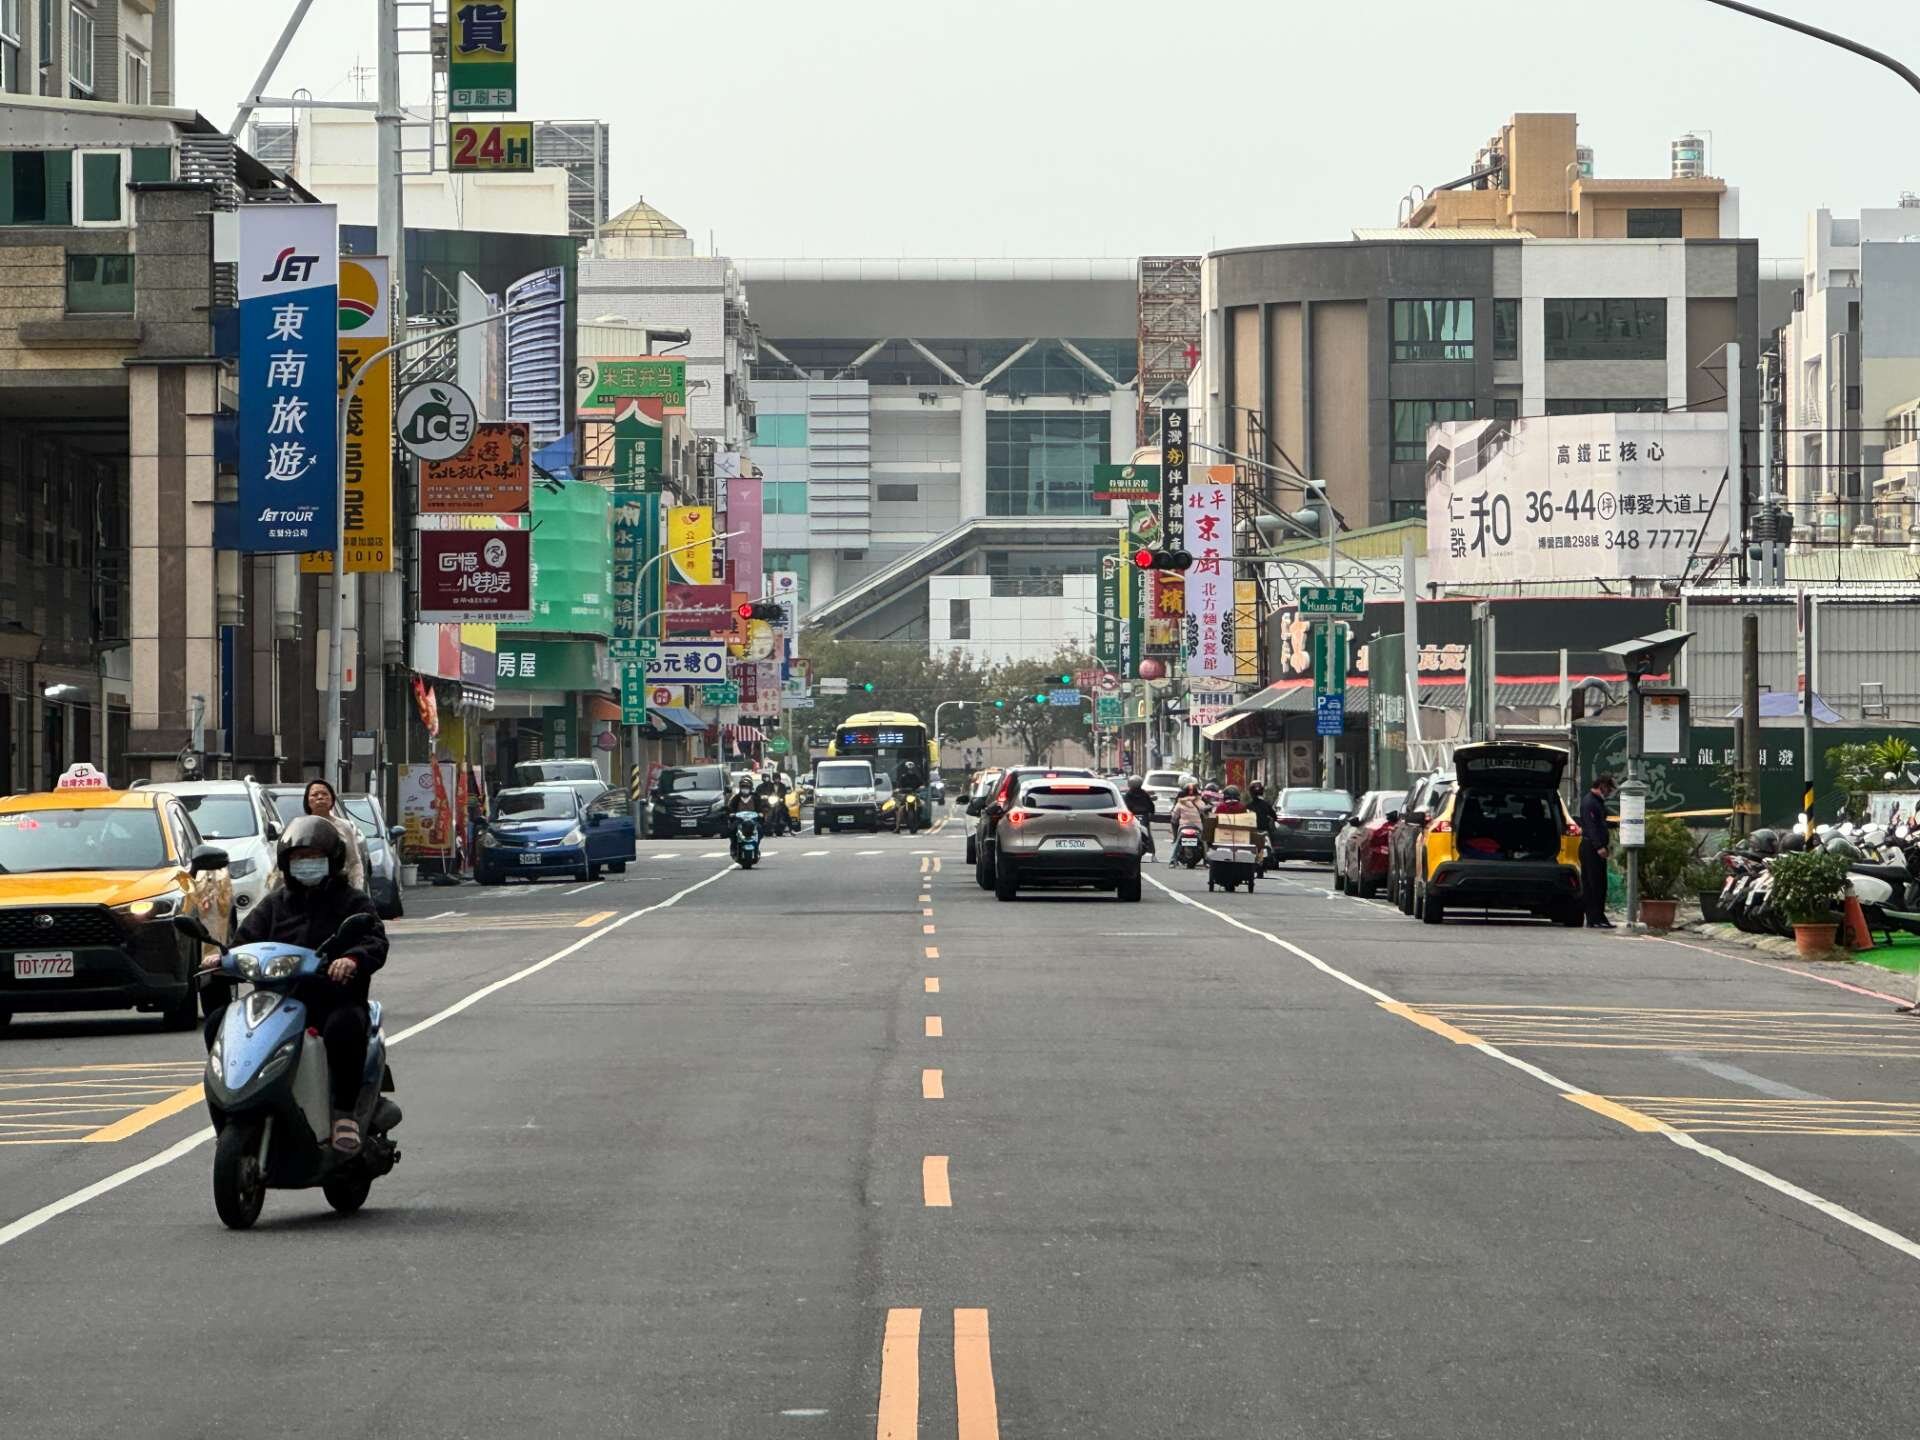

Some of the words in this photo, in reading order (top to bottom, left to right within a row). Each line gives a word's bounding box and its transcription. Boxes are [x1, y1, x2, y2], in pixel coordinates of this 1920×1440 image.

[457, 4, 507, 53] 貨
[456, 90, 509, 105] 可刷卡
[455, 127, 528, 165] 24H
[265, 303, 313, 480] 東南旅遊
[416, 414, 469, 442] ICE
[1557, 442, 1665, 465] 高鐵正核心
[1189, 491, 1226, 510] 北平
[1526, 490, 1596, 523] 36-44
[1618, 494, 1711, 515] 博愛大道上
[1605, 529, 1640, 549] 348
[1647, 529, 1698, 549] 7777
[497, 652, 537, 678] 房屋
[15, 958, 72, 976] TDT-7722
